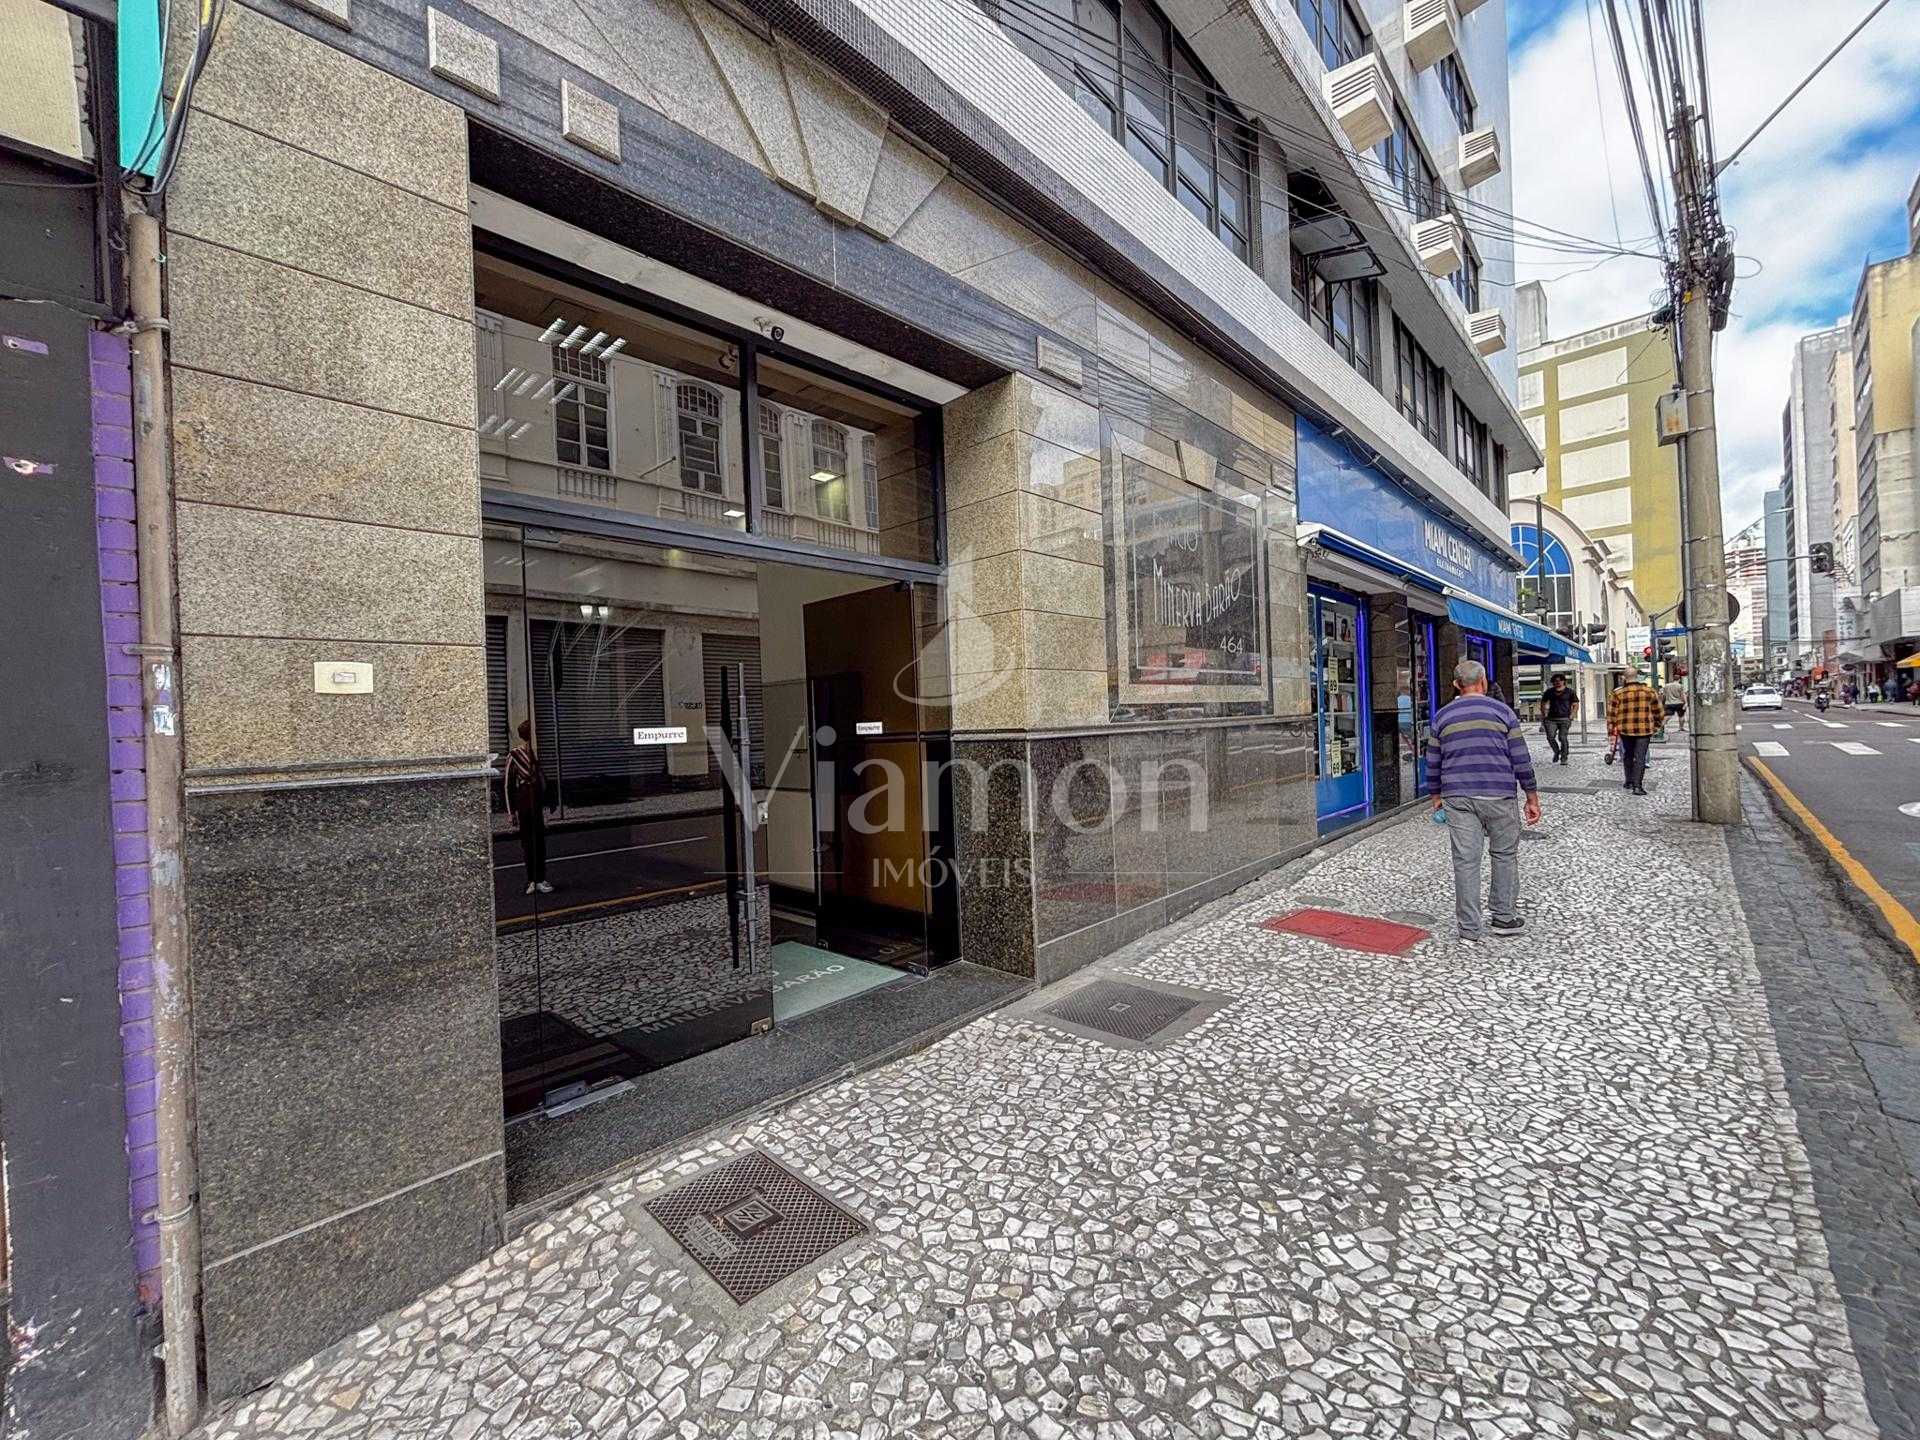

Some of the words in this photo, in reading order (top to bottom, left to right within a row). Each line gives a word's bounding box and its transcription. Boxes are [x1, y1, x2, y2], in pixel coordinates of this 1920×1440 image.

[1448, 535, 1472, 571] CENTER
[1153, 558, 1202, 627] MINERVA
[1220, 636, 1243, 655] 464
[637, 731, 685, 741] Empurre
